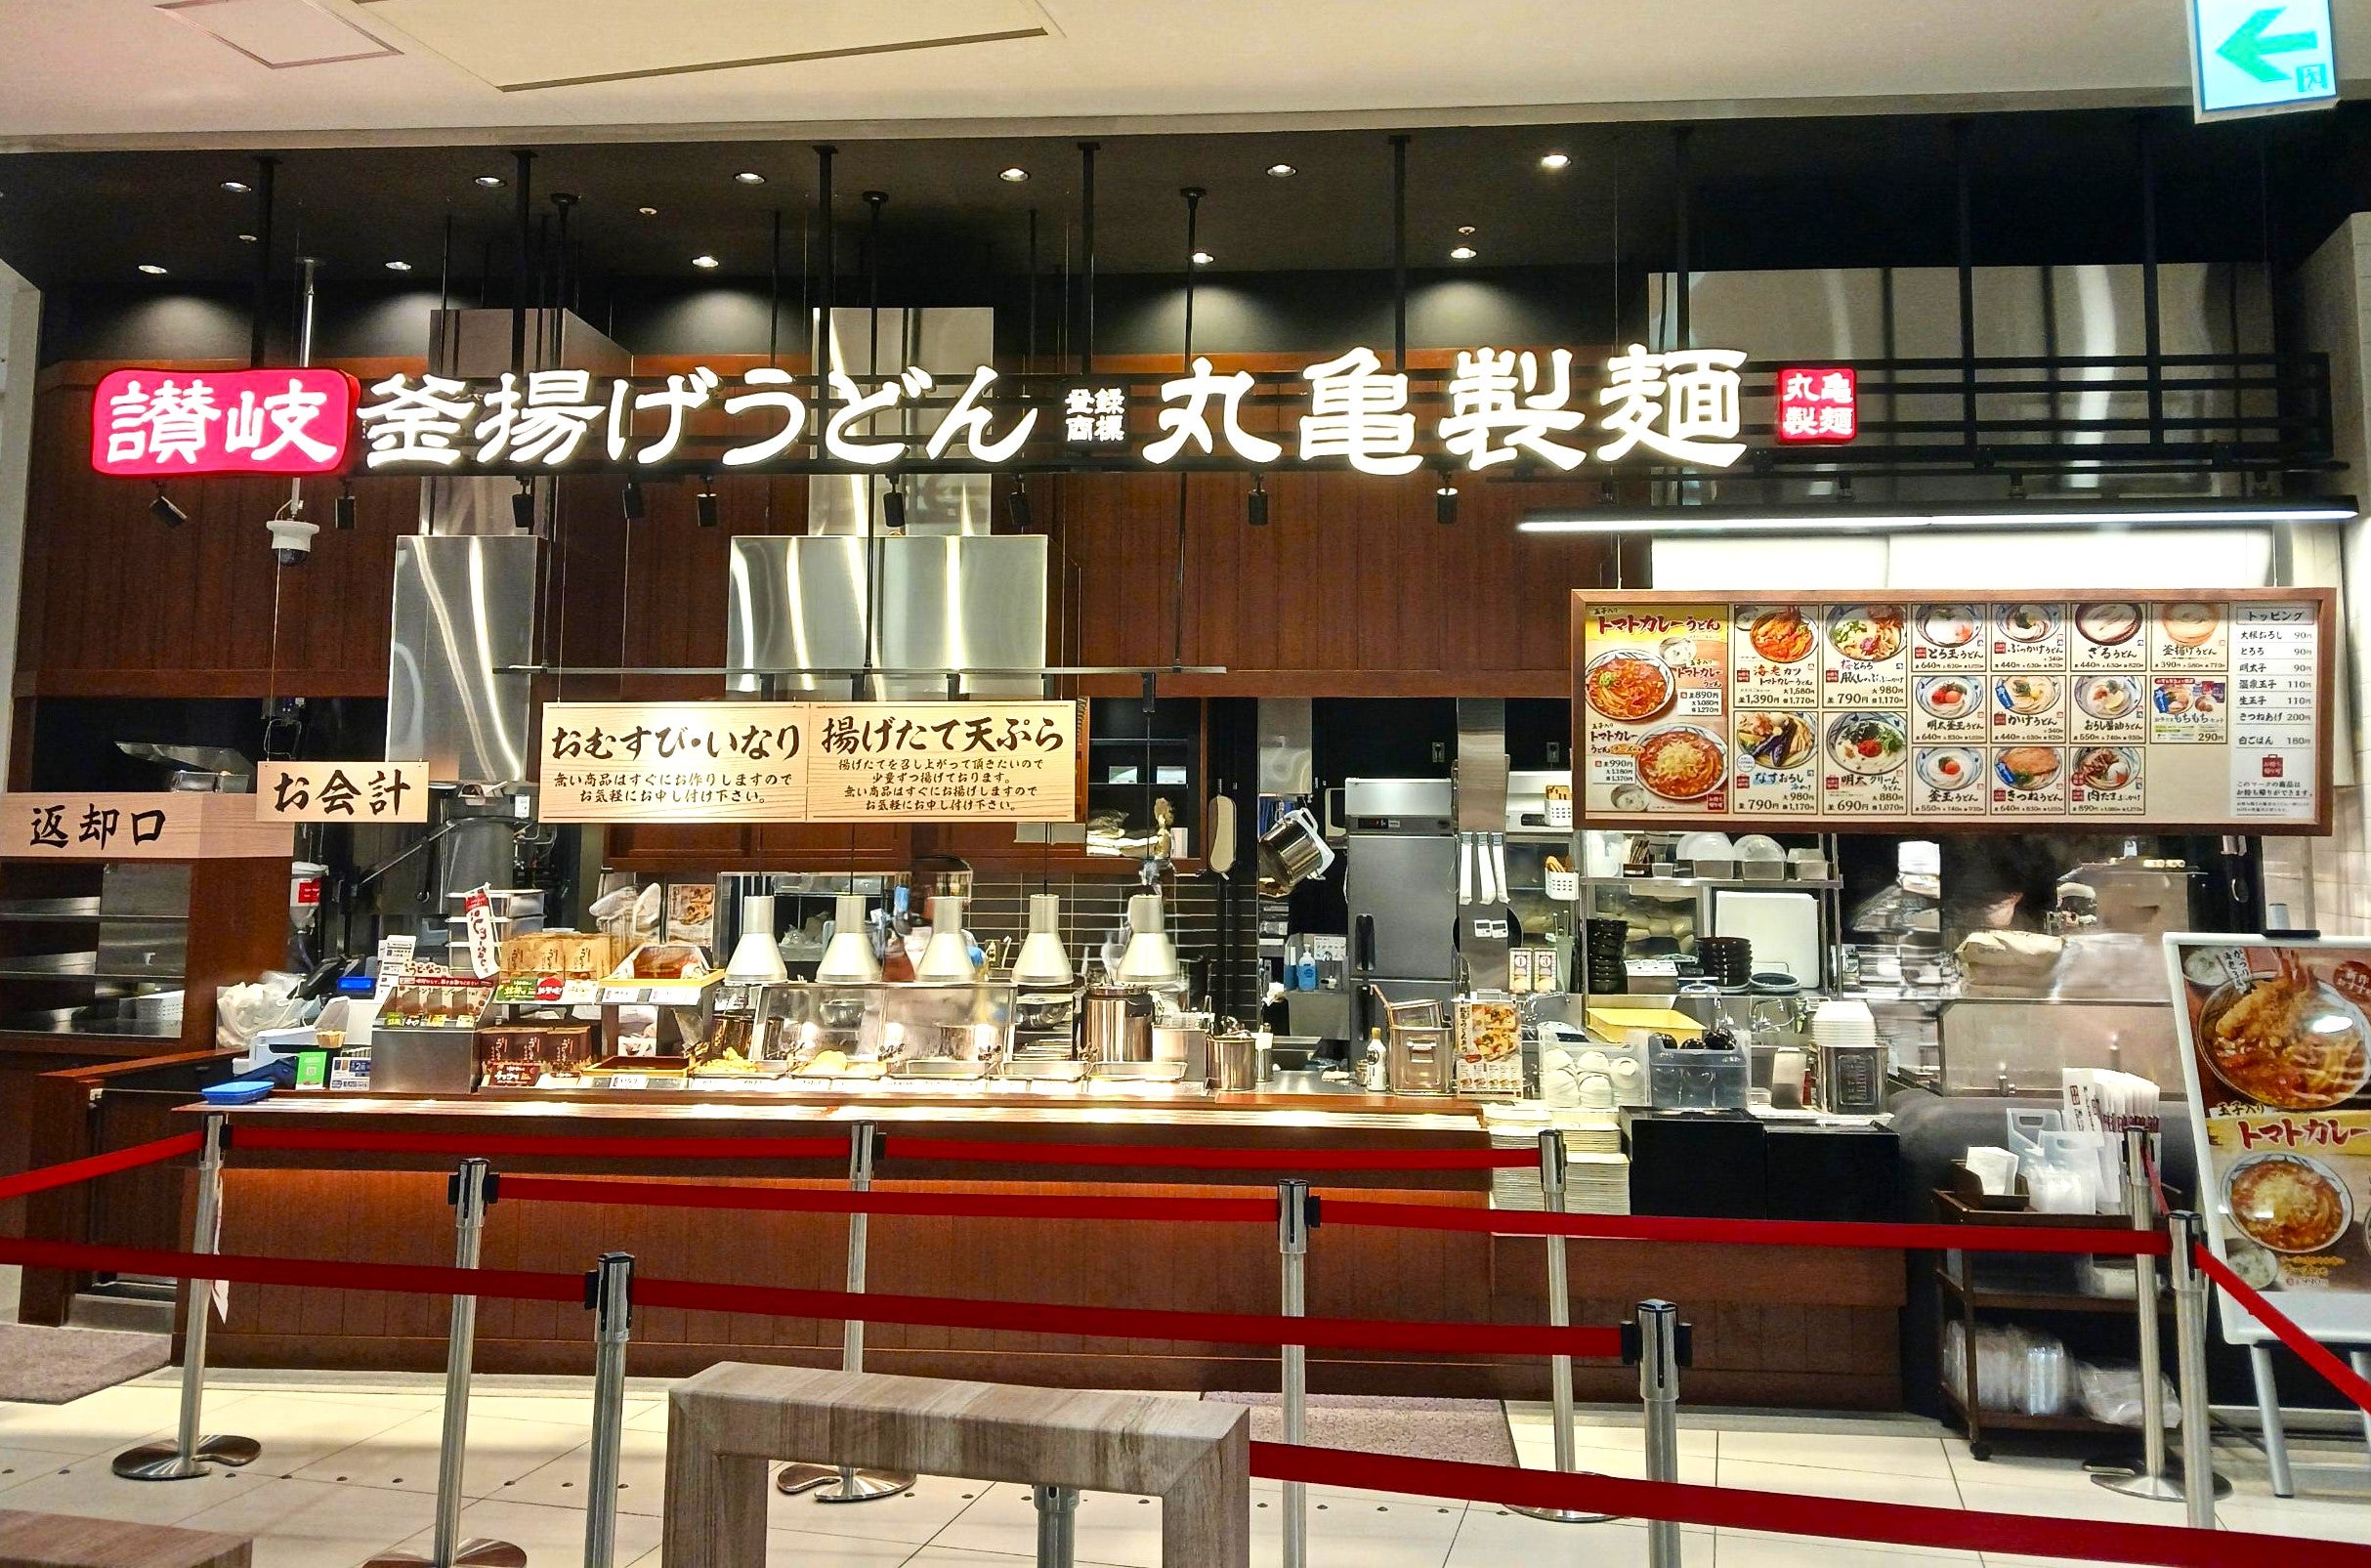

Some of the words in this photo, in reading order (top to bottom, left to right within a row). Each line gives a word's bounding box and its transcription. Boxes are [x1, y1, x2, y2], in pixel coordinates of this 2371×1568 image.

[1783, 372, 1854, 403] 丸亀
[107, 378, 337, 464] 讃岐
[357, 365, 1038, 467] 釜揚げうどん
[1143, 345, 1748, 475] 丸亀製麺
[1783, 406, 1854, 436] 製麺
[2249, 611, 2305, 621] トッピング
[1598, 614, 1721, 634] トマトカレーうどん
[2240, 630, 2282, 640] 大根おろし
[1927, 648, 1984, 659] とろ玉うどん
[2088, 645, 2138, 659] ざるうどん
[2241, 647, 2265, 656] とろろ
[1754, 664, 1801, 676] 海老カツ
[2008, 715, 2057, 727] かけうどん
[822, 716, 1064, 755] 揚げたて天ぷら
[1590, 730, 1638, 742] トマトカレー
[2238, 736, 2273, 744] 白ごはん
[552, 725, 800, 761] おむすび・いなり
[838, 758, 1044, 771] 揚げたてを召し上がって頂きたいので
[554, 772, 793, 787] 無い商品はすぐにお作りしますので
[872, 771, 1011, 784] 少量ずつ揚げております。
[1755, 771, 1804, 784] なすおろし
[274, 769, 411, 816] お会計
[579, 789, 766, 804] お気軽にお申し付け下さい。
[844, 785, 1038, 797] 無い商品はすぐにお揚げしますので
[1928, 789, 1978, 802] 釜玉うどん
[2007, 789, 2063, 802] きつねうどん
[866, 799, 1016, 812] お気軽にお申し付け下さい。
[30, 803, 166, 851] 返却口
[2218, 1101, 2265, 1117] 玉子入り
[2237, 1118, 2369, 1150] トマトカレー
